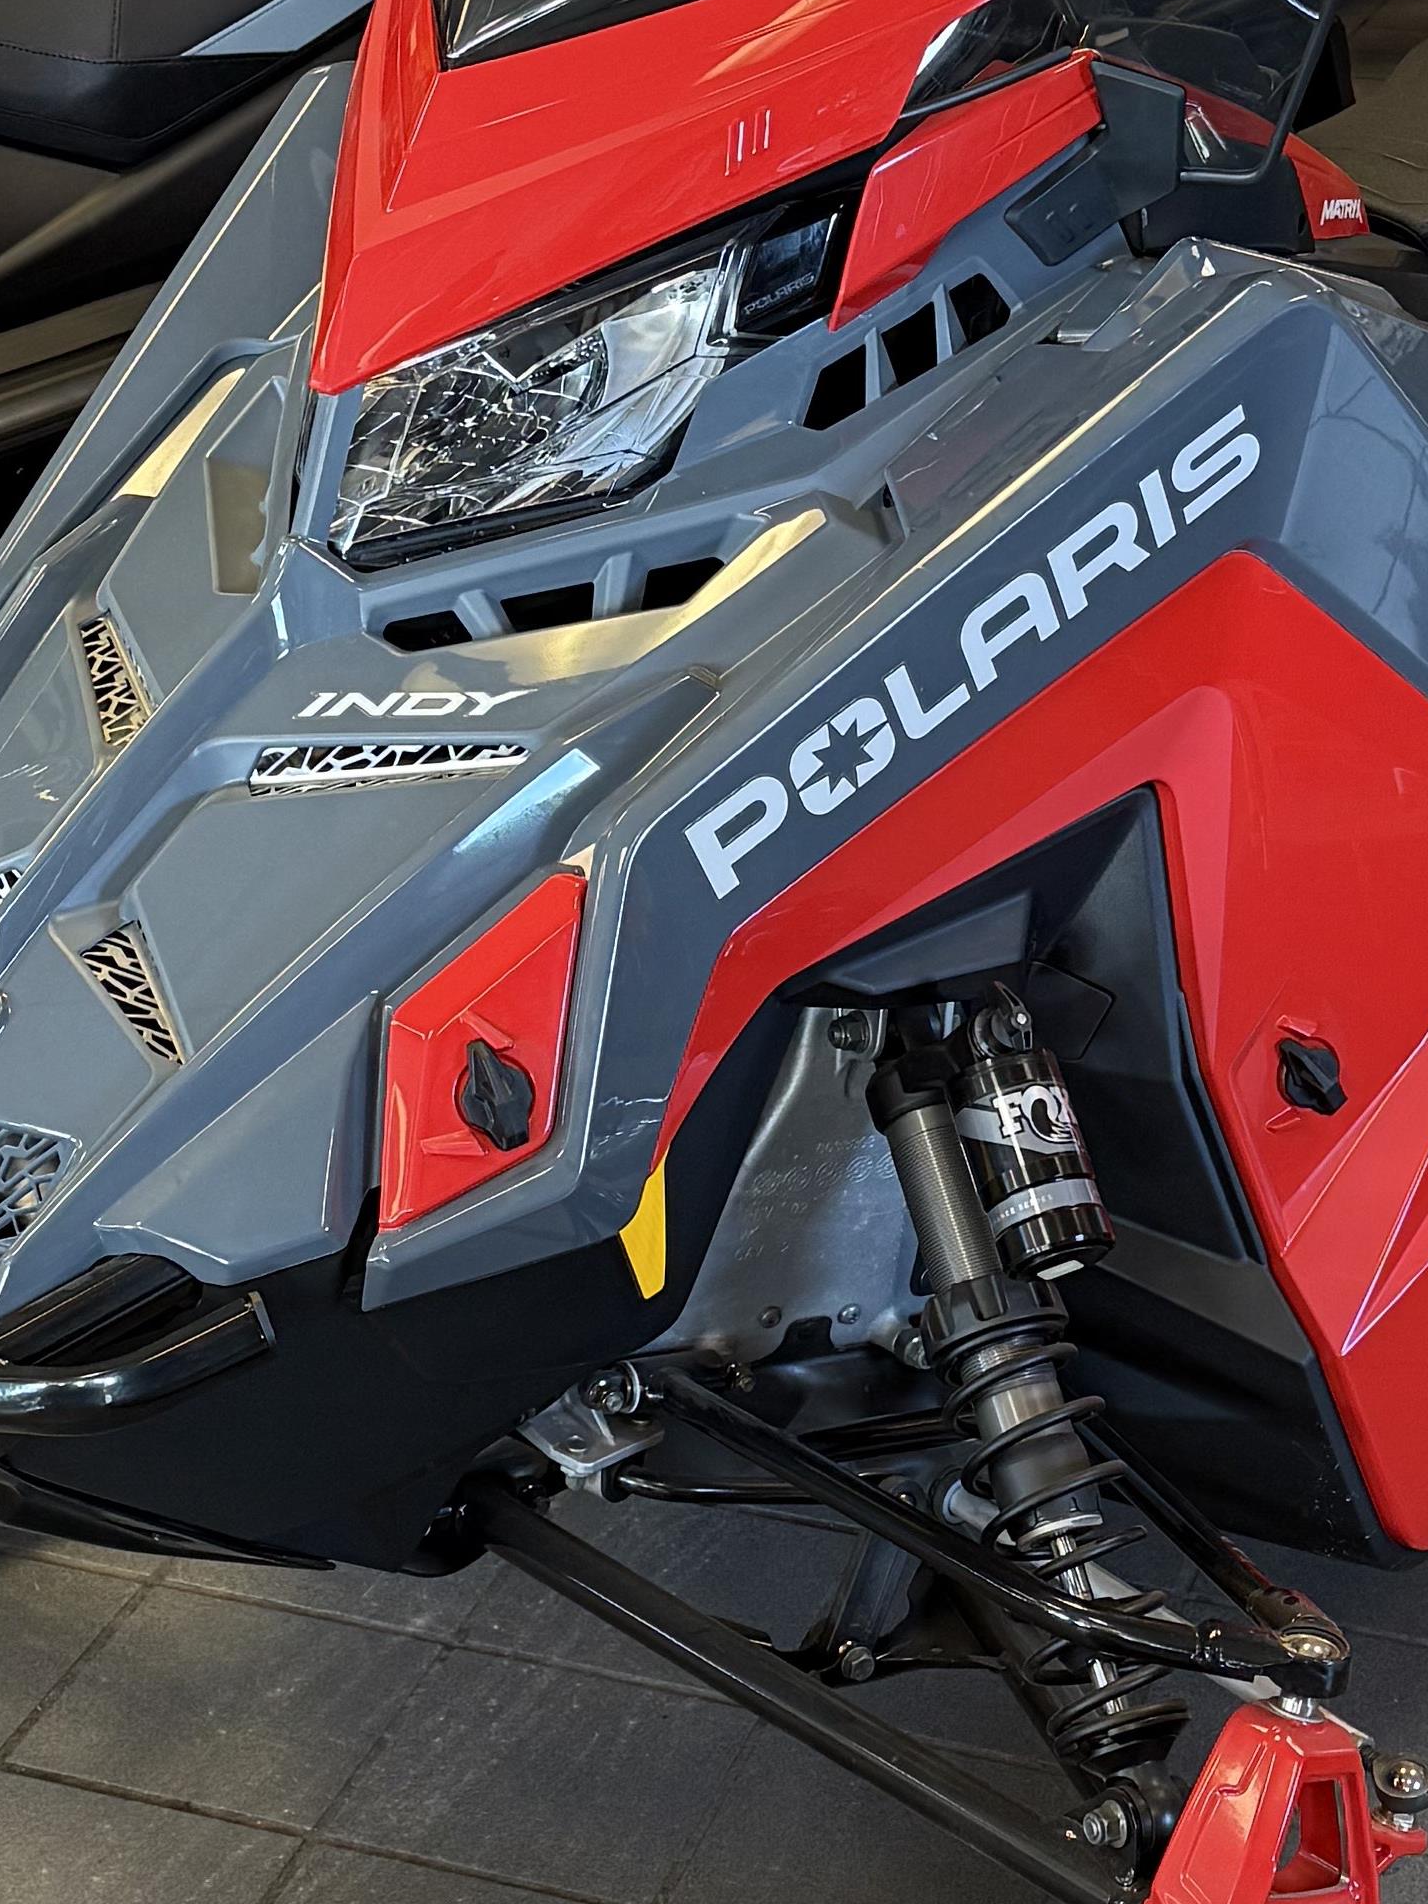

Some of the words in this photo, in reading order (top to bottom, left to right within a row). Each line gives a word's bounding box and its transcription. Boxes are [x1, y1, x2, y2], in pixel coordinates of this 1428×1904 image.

[743, 271, 815, 316] POLARIS
[683, 403, 1262, 900] POLARIS
[292, 688, 538, 721] INDY
[992, 1084, 1078, 1143] FOX
